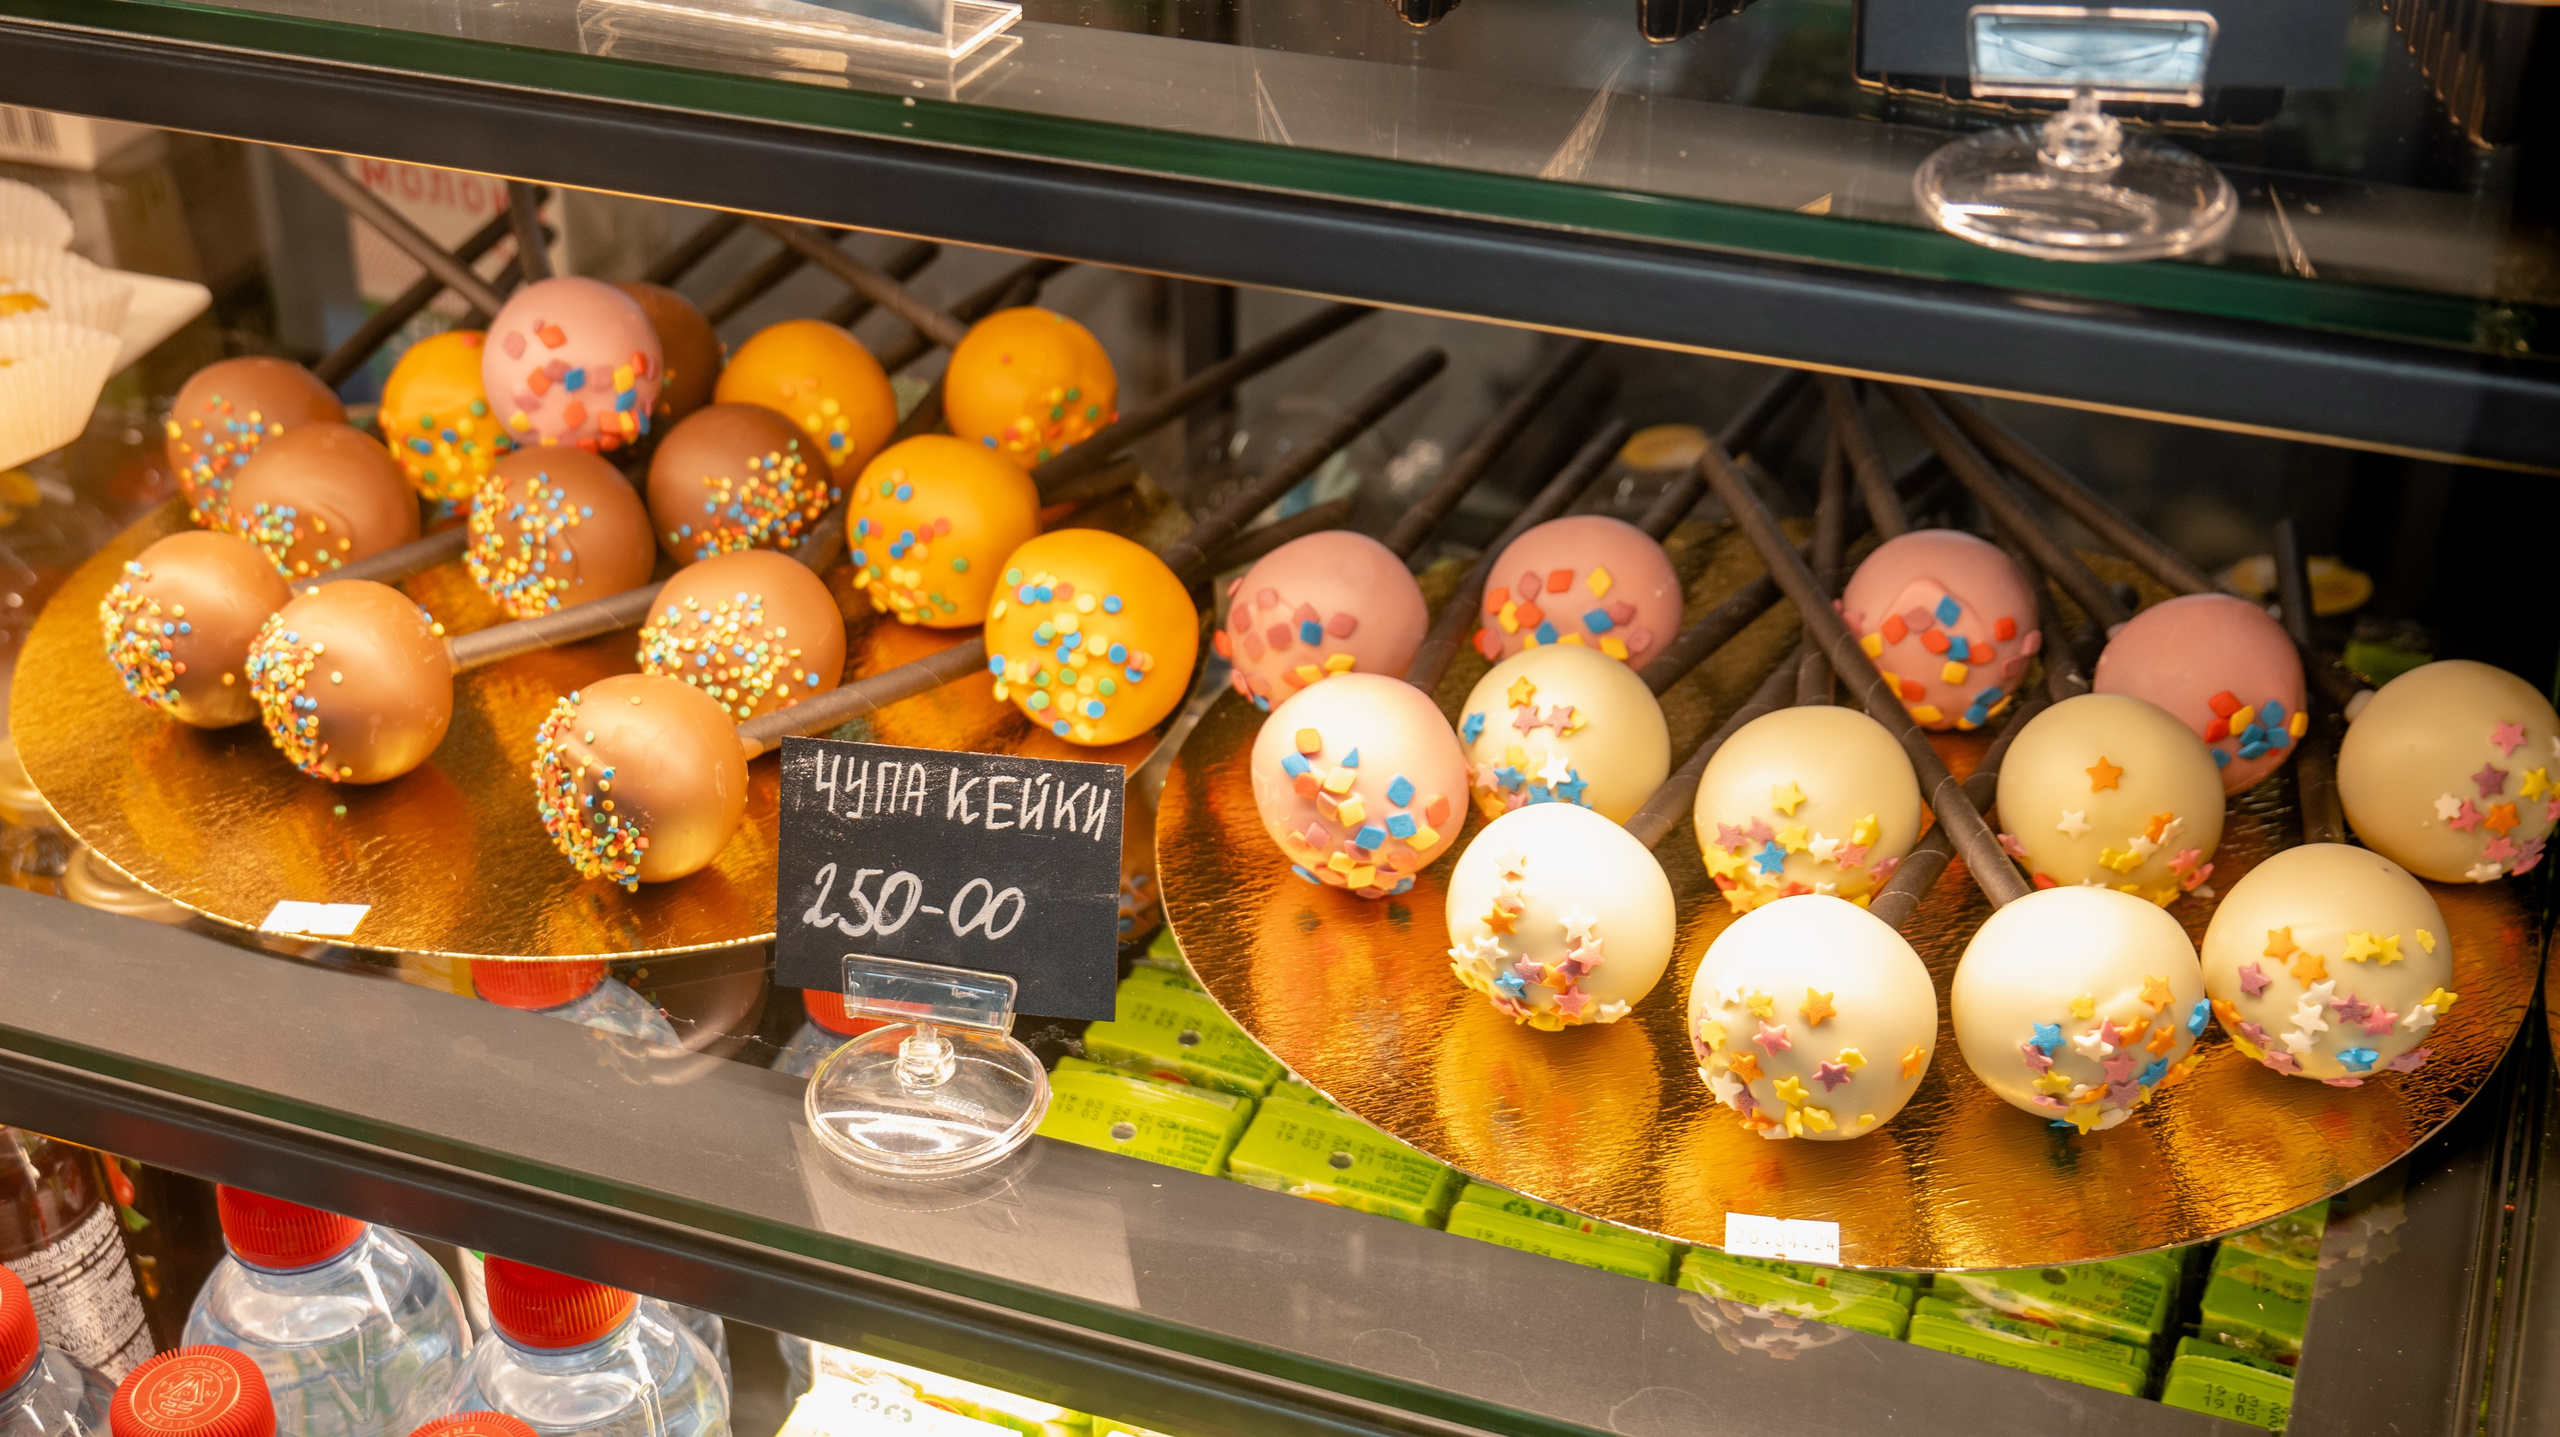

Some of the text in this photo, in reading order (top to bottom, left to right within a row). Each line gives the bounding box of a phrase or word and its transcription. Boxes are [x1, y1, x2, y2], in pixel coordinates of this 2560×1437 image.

[815, 749, 1111, 841] ЧУПА КЕЙКИ
[803, 862, 1026, 940] 250-00
[172, 1359, 232, 1382] FRANCE
[141, 1408, 196, 1427] VITTEL
